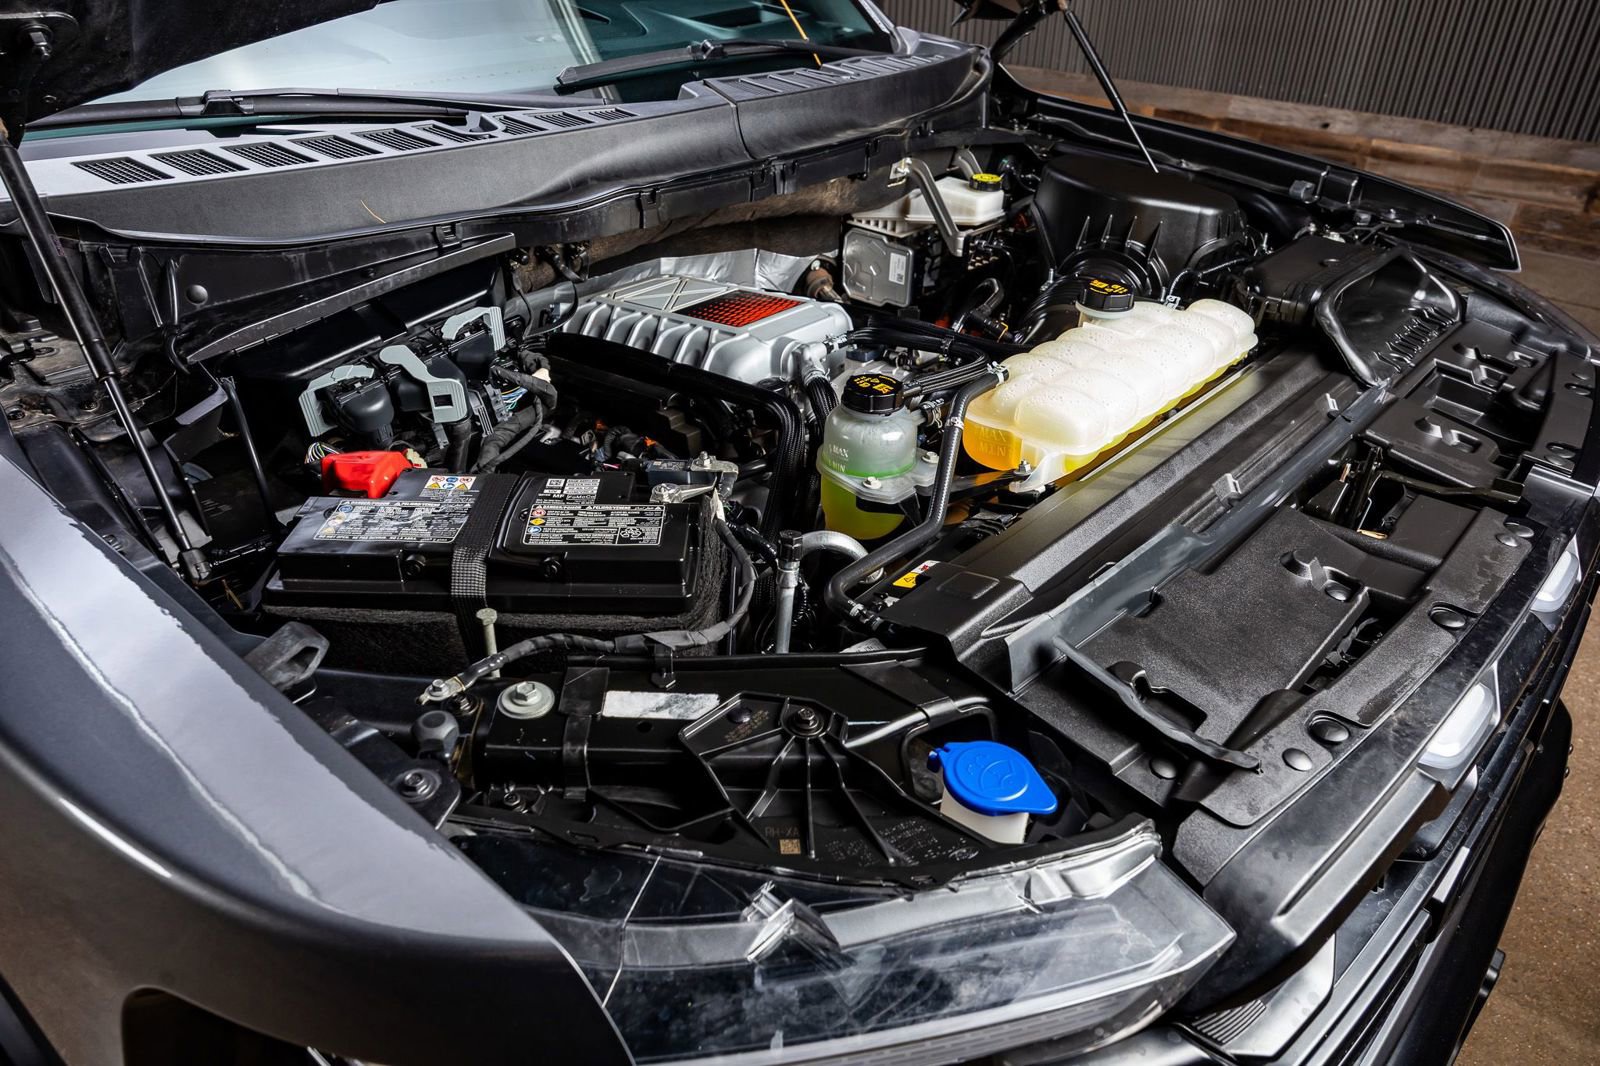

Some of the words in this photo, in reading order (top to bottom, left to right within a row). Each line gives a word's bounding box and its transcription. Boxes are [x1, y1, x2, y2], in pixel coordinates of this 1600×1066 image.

[833, 445, 849, 458] MAX
[980, 441, 1006, 457] MIN
[832, 462, 846, 473] MIN
